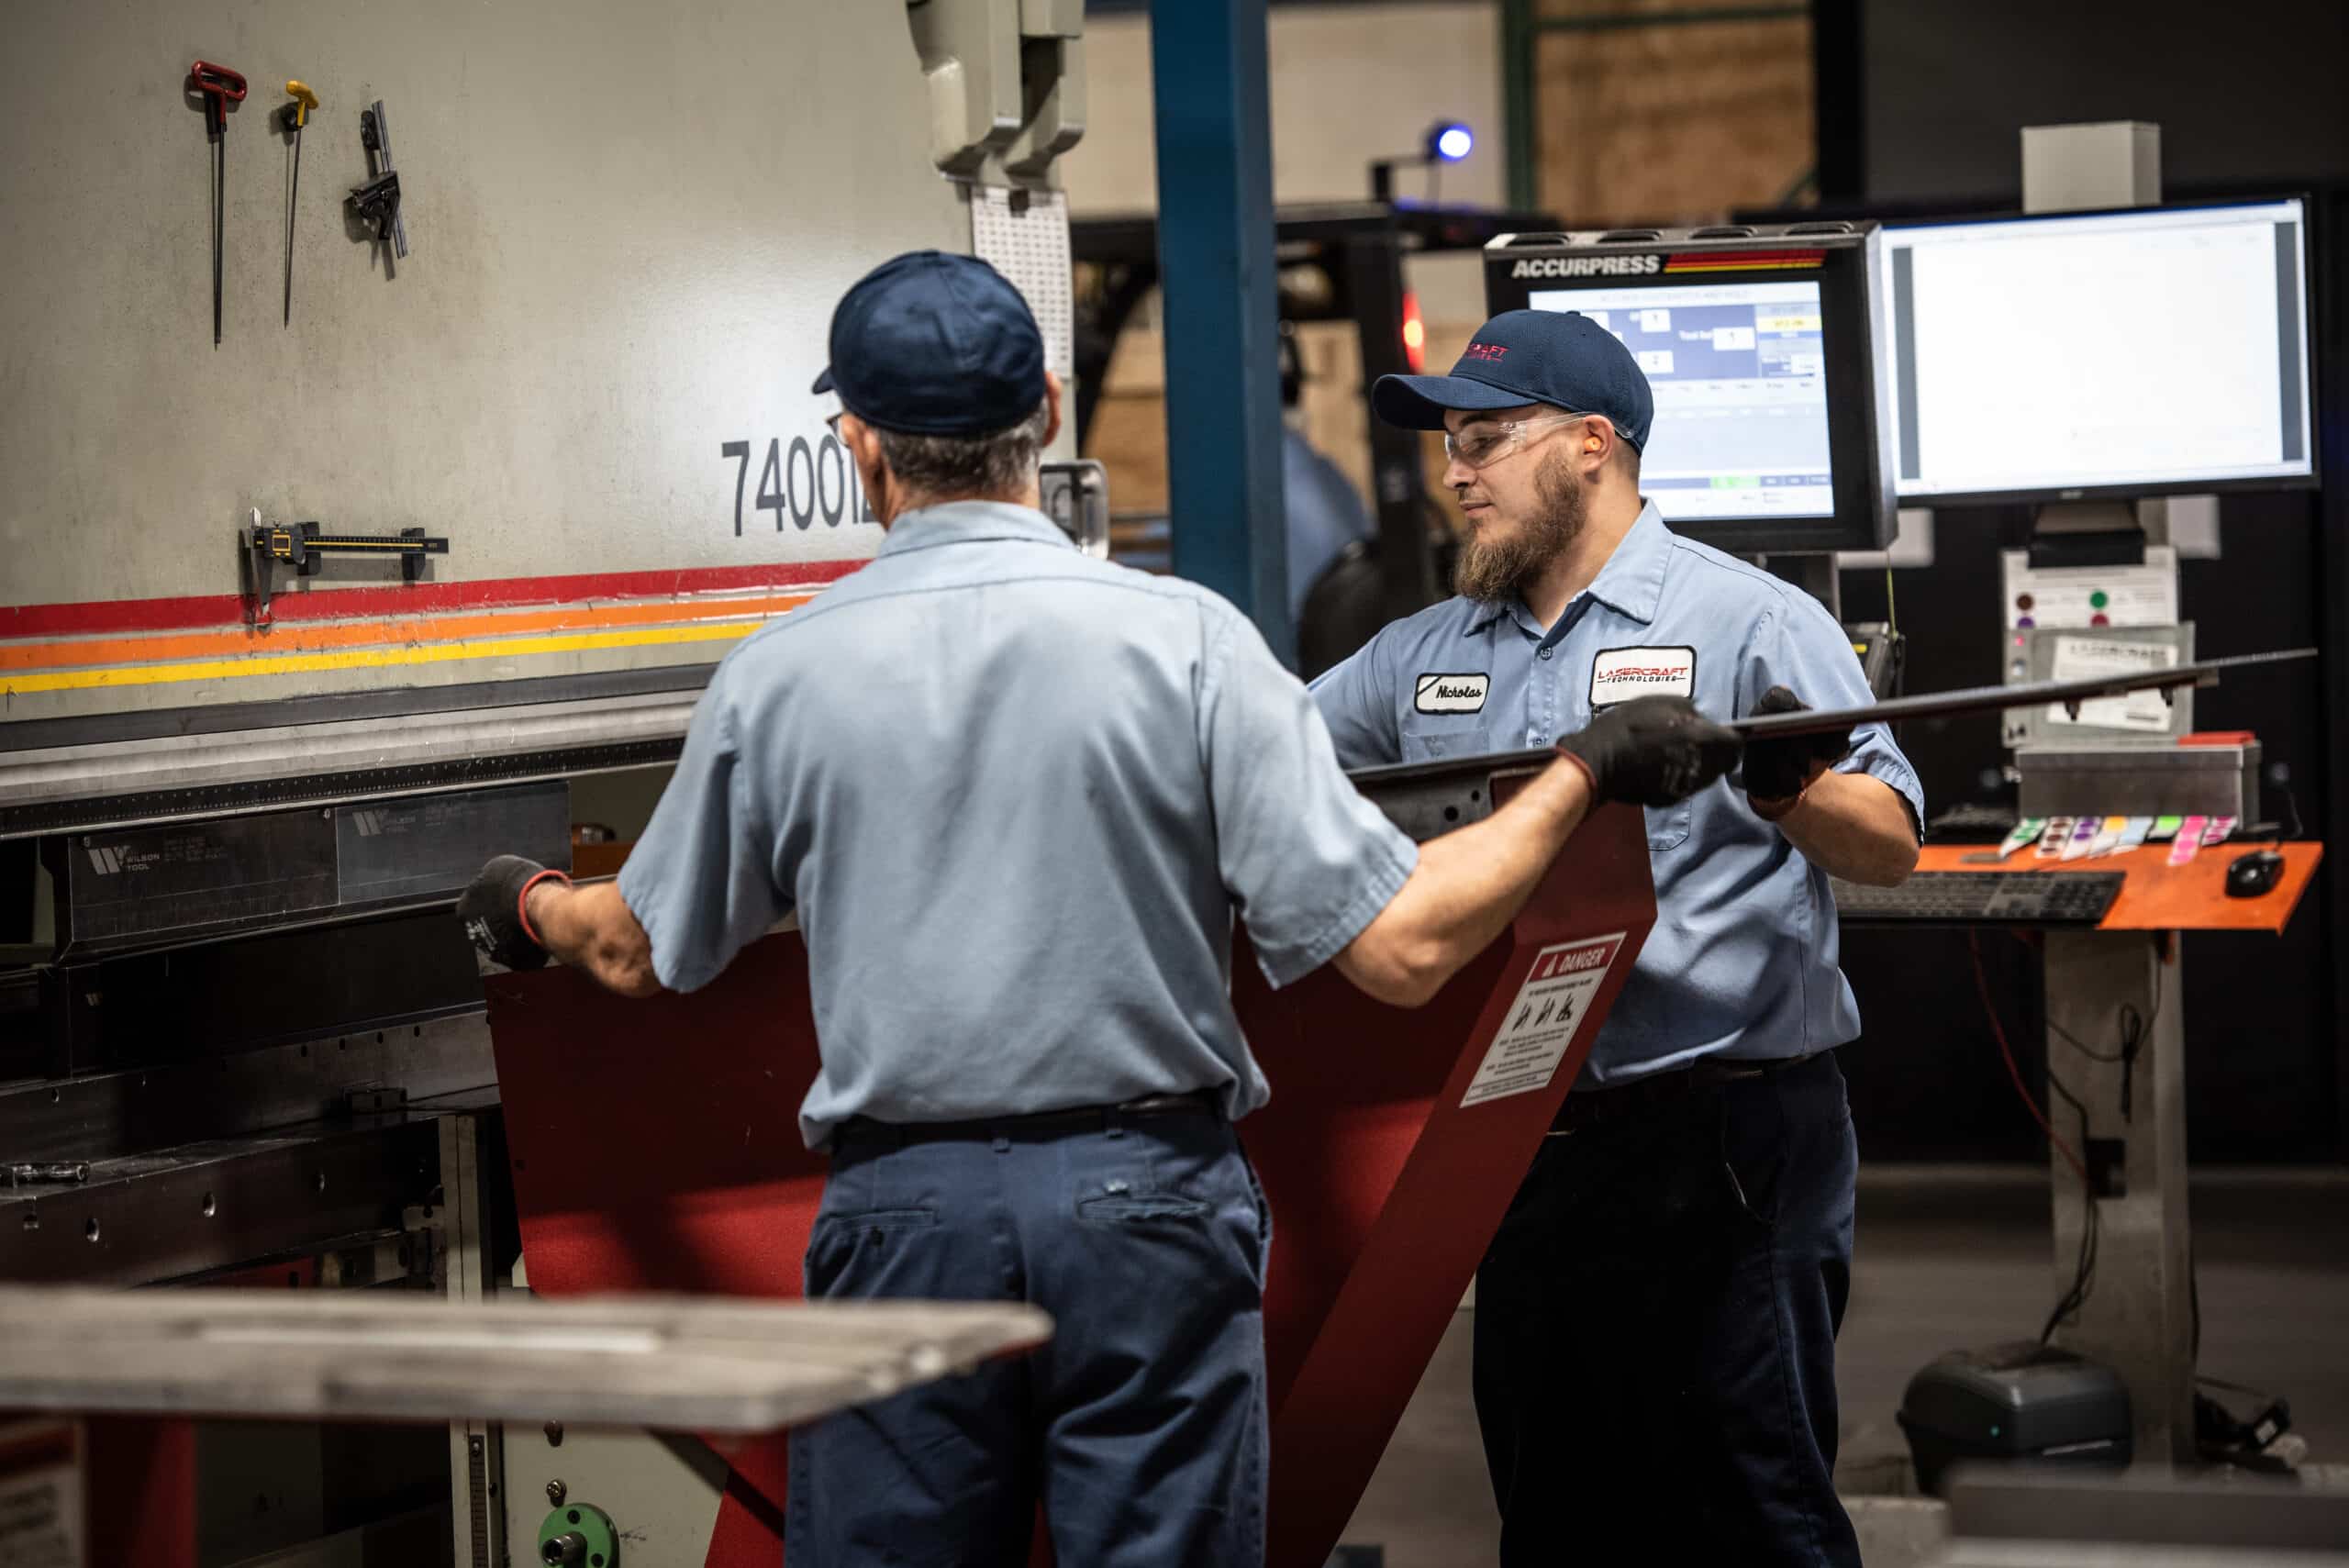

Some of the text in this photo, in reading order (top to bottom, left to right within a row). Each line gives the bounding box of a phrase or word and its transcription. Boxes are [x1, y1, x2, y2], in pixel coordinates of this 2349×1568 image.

[1512, 255, 1660, 278] ACCURPRESS
[1598, 667, 1688, 679] LASERCRAFT
[1607, 675, 1677, 684] TECHNOLOGIES
[1435, 684, 1483, 698] Nicholas
[1558, 947, 1606, 973] DANGER
